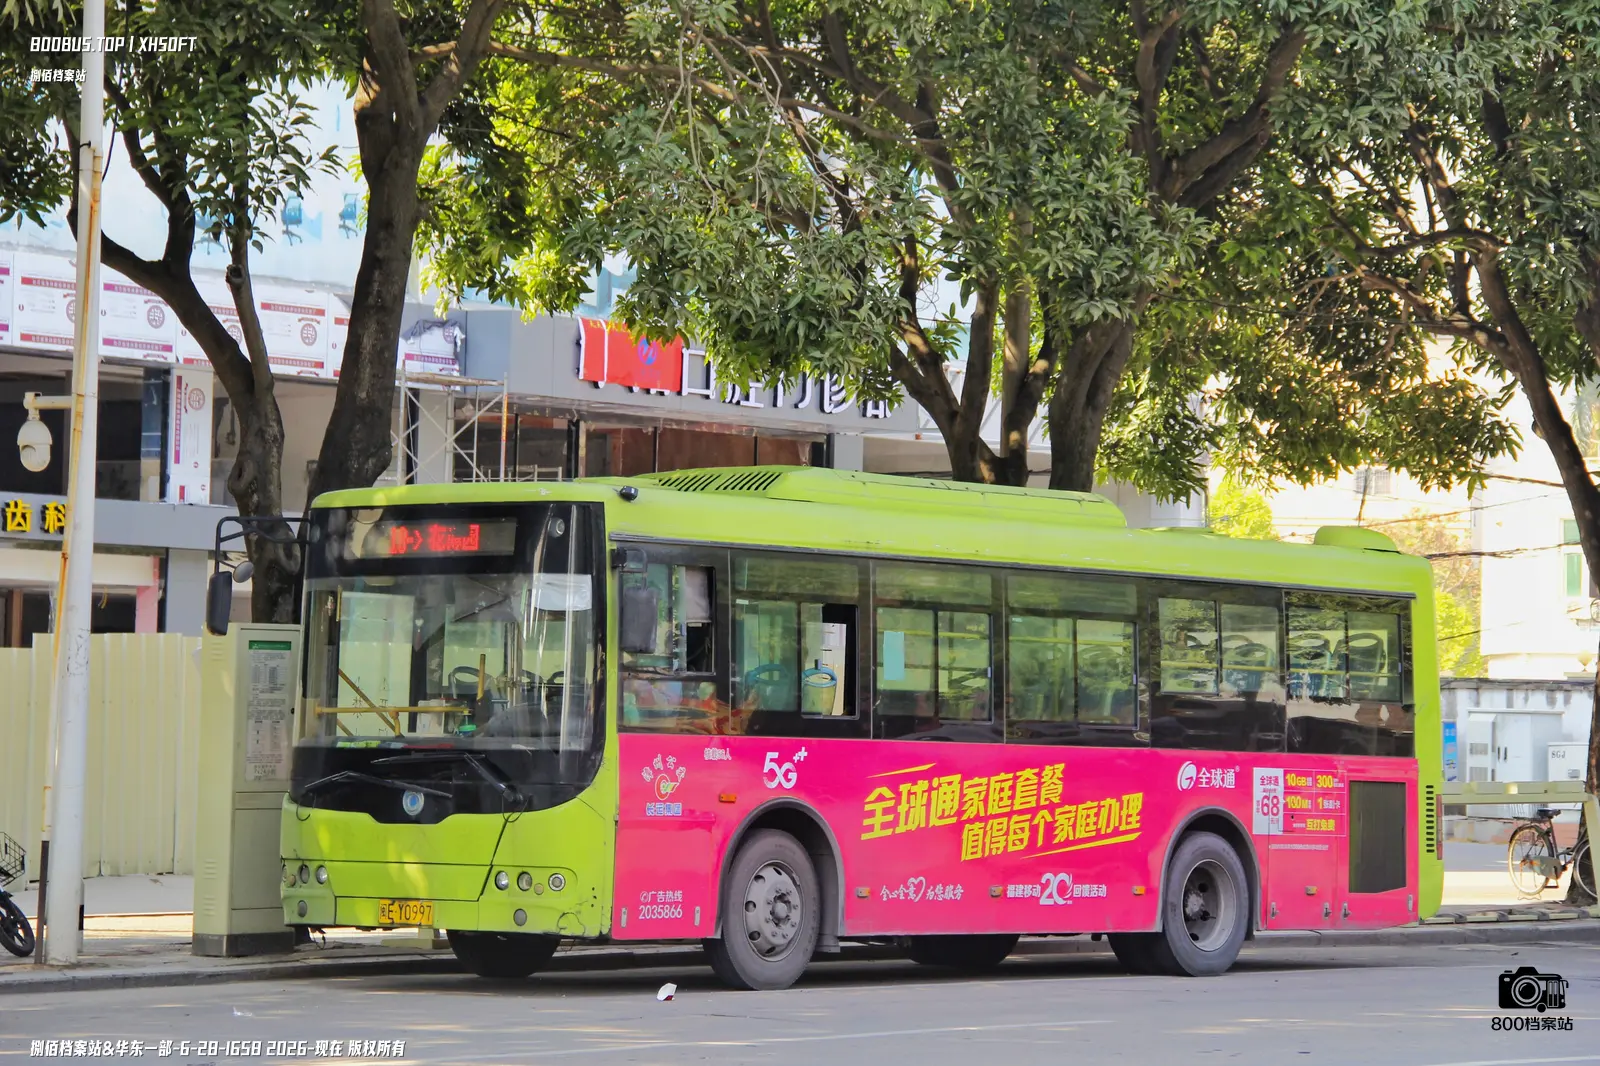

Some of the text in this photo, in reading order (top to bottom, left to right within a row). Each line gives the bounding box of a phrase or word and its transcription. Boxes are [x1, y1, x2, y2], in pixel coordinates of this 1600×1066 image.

[1198, 767, 1236, 789] 全球通
[1316, 775, 1333, 788] 300
[646, 803, 682, 816] 长运集团
[860, 763, 1065, 840] 全球通家庭套餐
[1261, 795, 1279, 816] 68
[960, 792, 1144, 862] 值得每个家庭办理
[648, 890, 683, 903] 广告热线
[639, 904, 683, 919] 2035866
